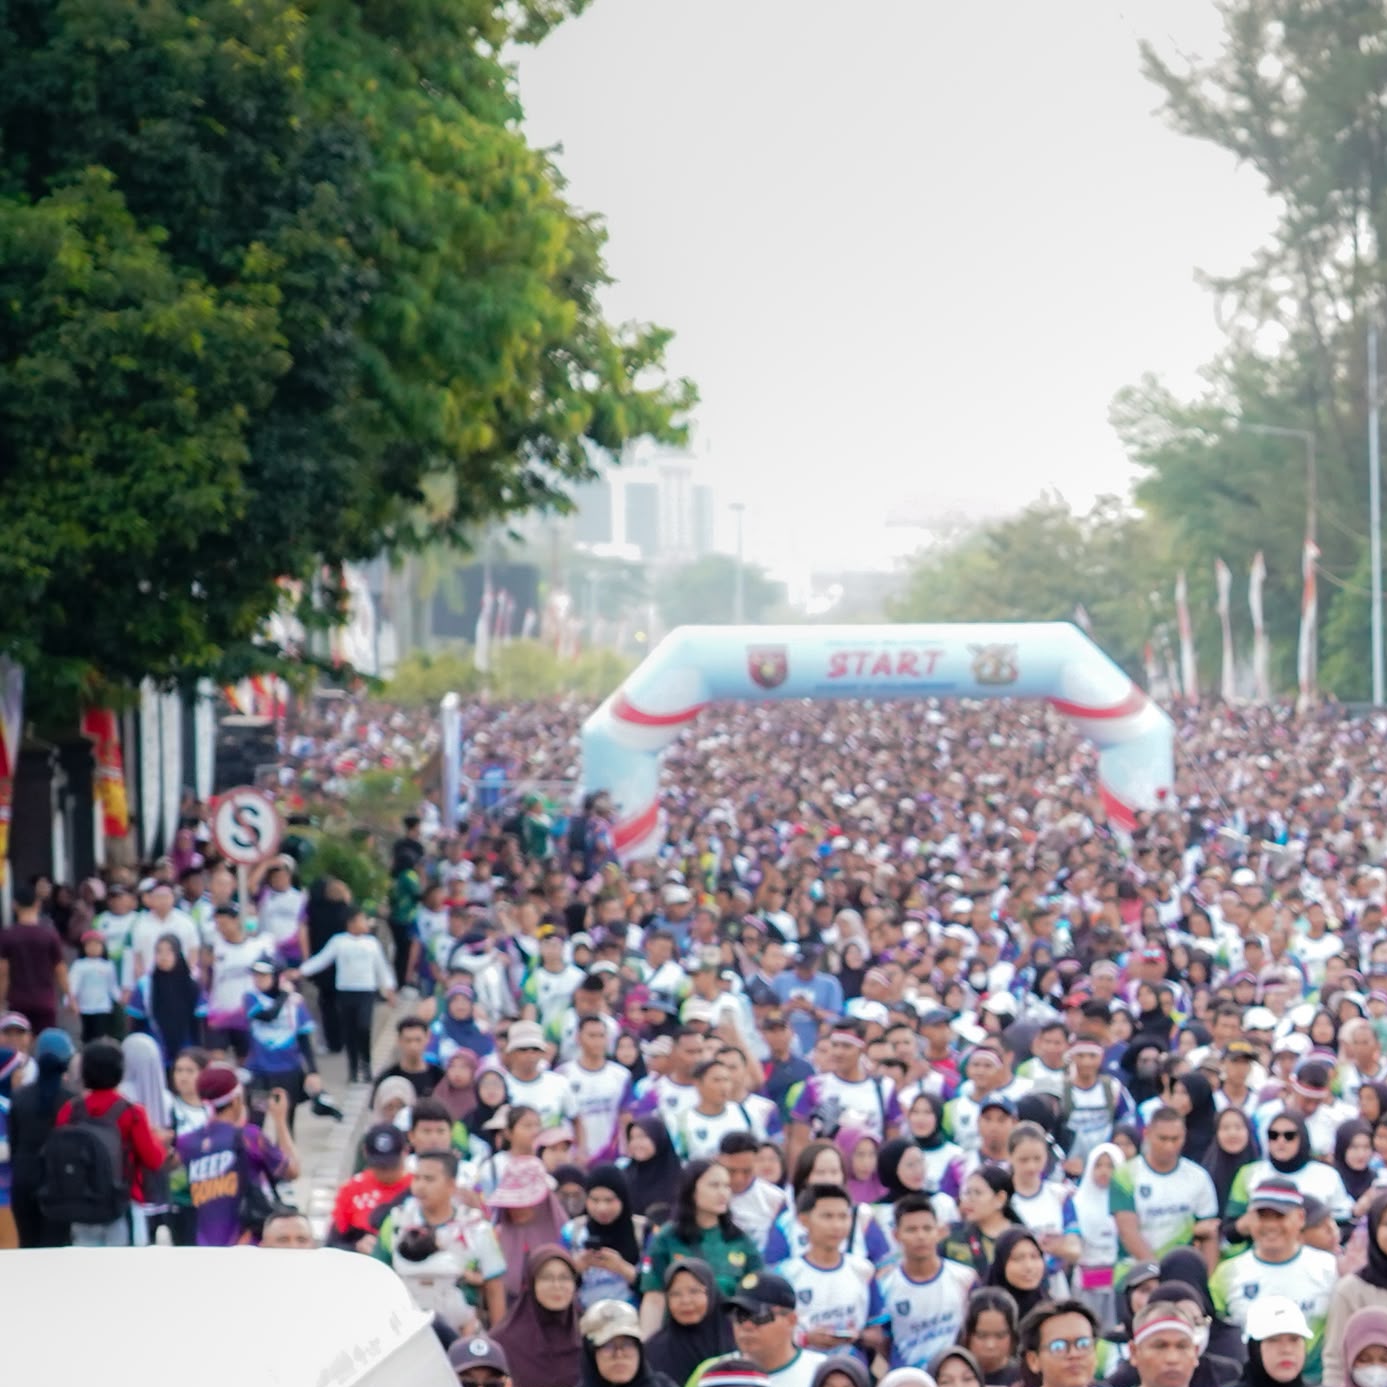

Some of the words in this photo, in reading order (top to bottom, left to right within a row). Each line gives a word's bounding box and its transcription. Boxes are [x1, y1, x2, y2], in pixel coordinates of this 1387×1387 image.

[827, 650, 945, 678] START
[231, 805, 261, 848] S
[189, 1150, 237, 1183] KEEP
